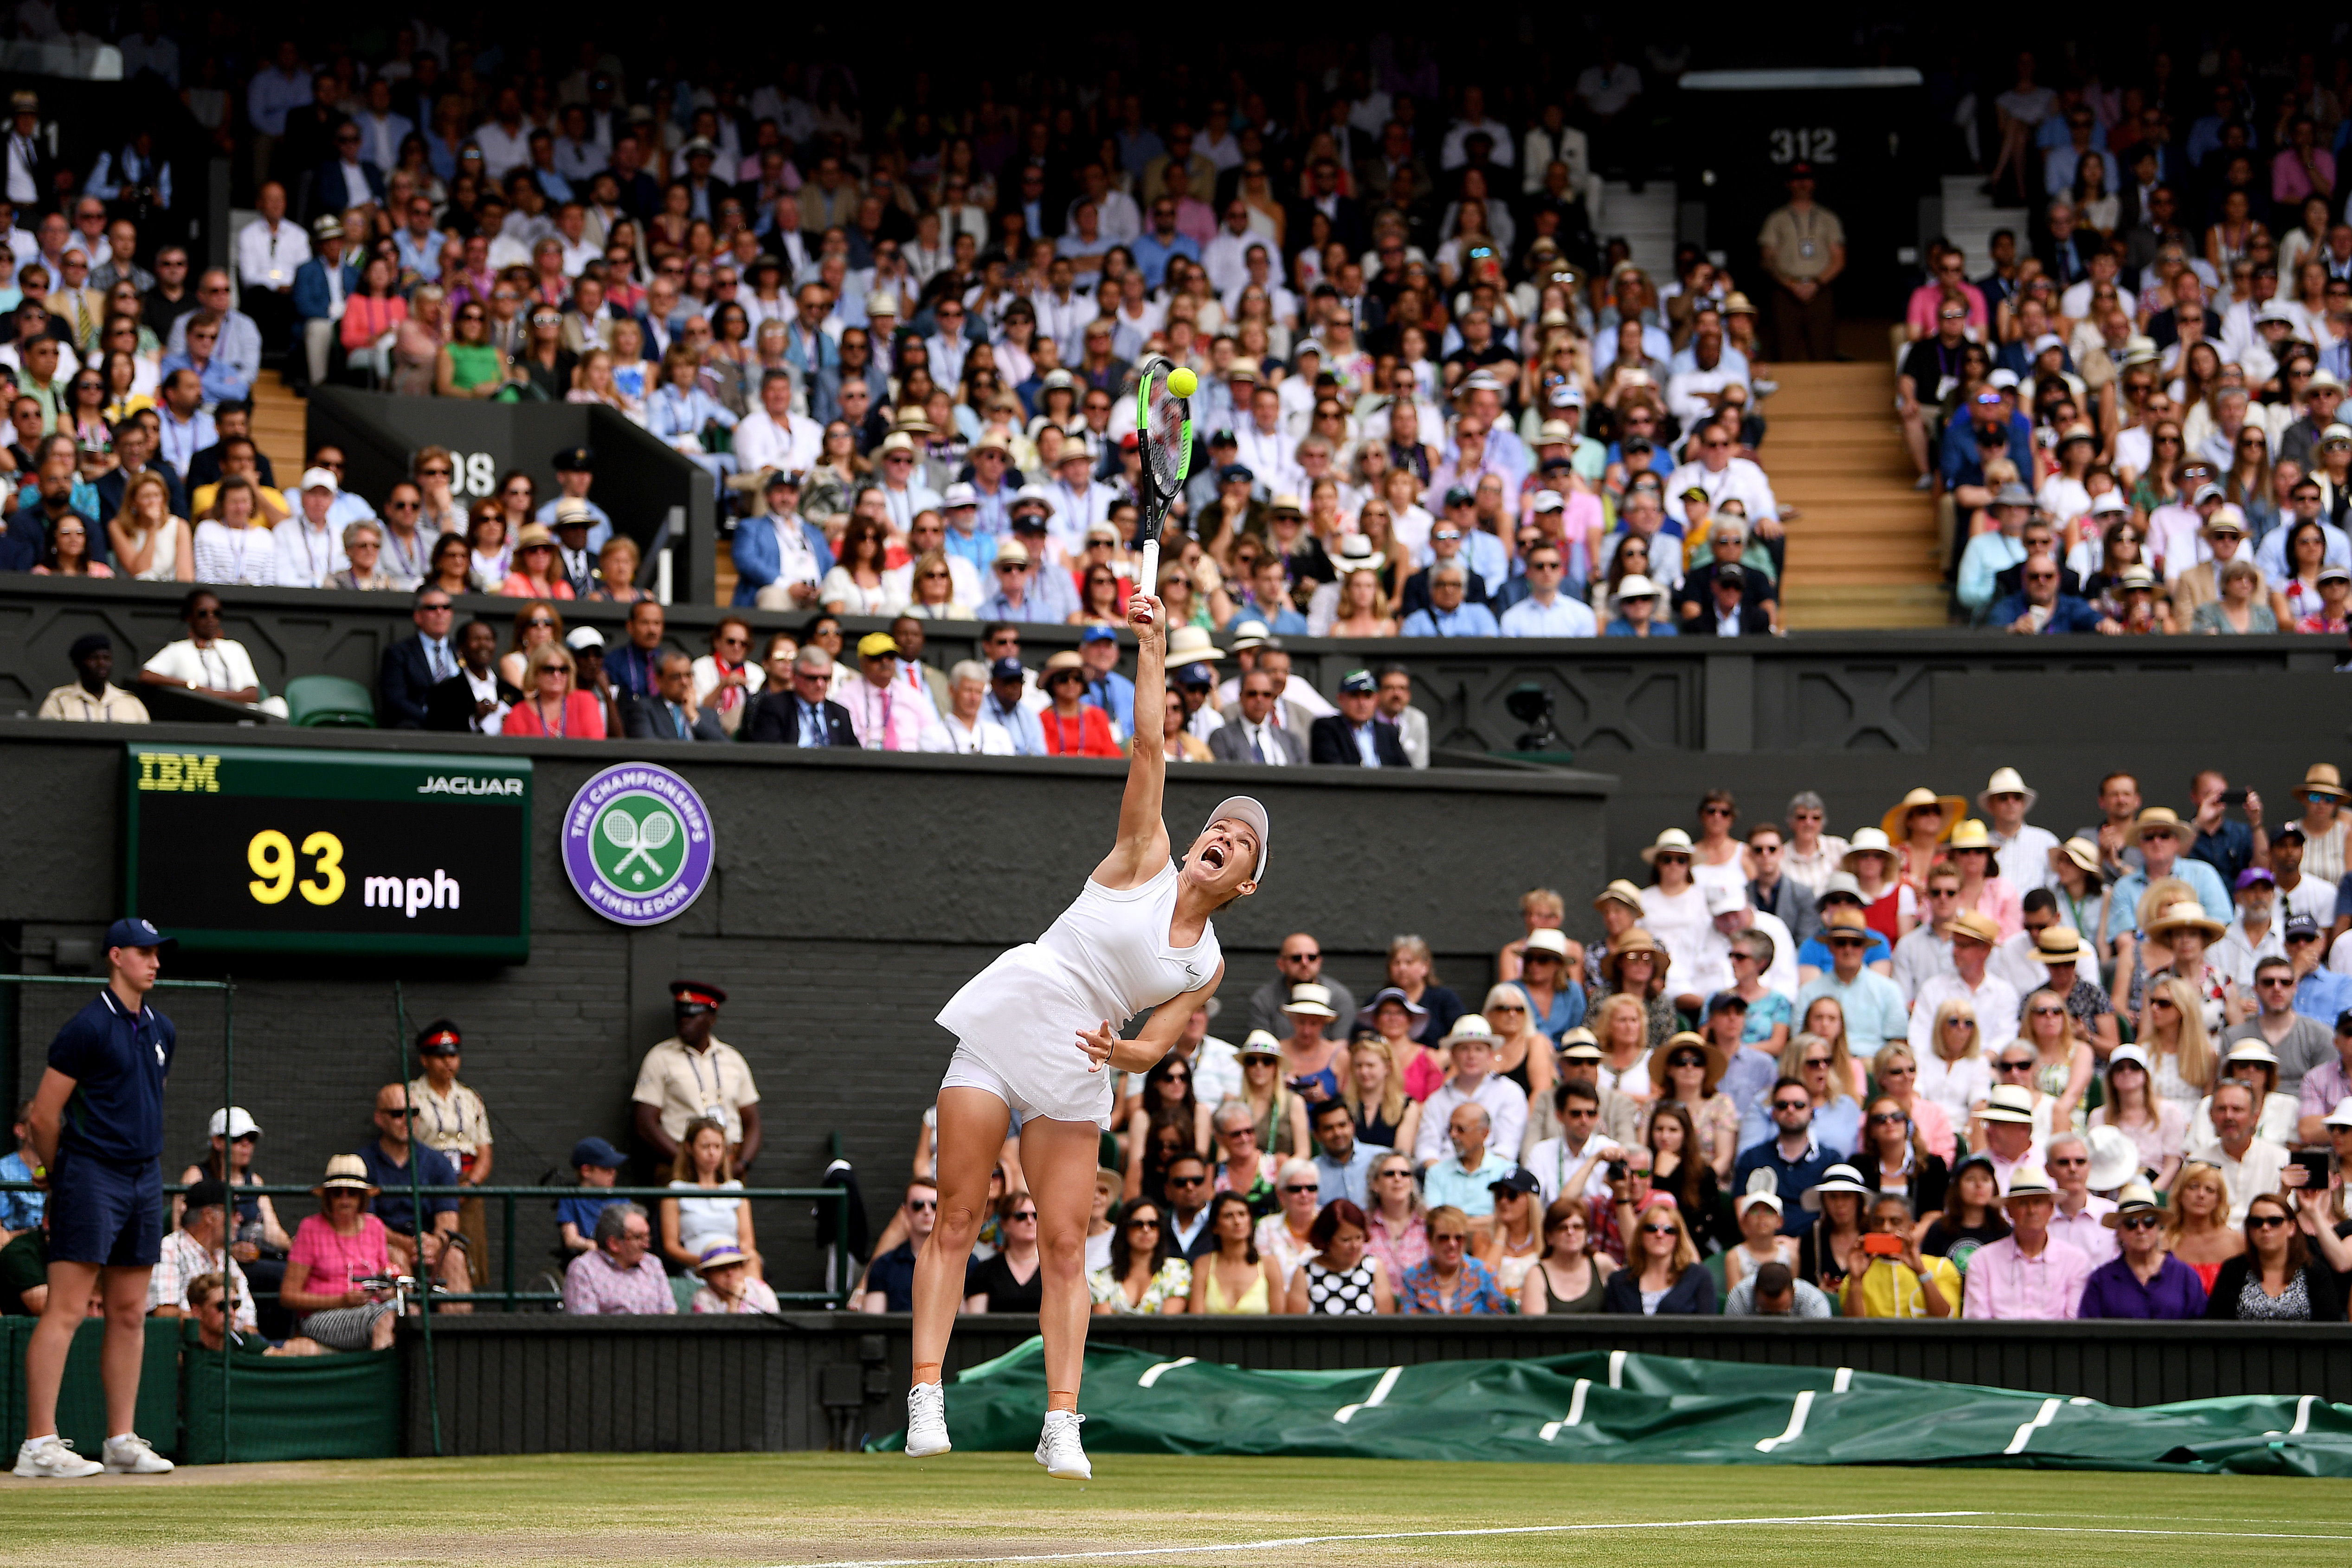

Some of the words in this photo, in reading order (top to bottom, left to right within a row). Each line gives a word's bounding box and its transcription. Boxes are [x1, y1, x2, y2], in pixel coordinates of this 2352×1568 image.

[1769, 126, 1838, 165] 312
[138, 752, 220, 792] IBM
[418, 776, 523, 796] JAGUAR
[571, 800, 594, 838] THE
[589, 771, 707, 843] CHAMPIONSHIPS
[247, 829, 346, 906] 93
[364, 869, 460, 918] mph
[589, 880, 689, 917] WIMBLEDON
